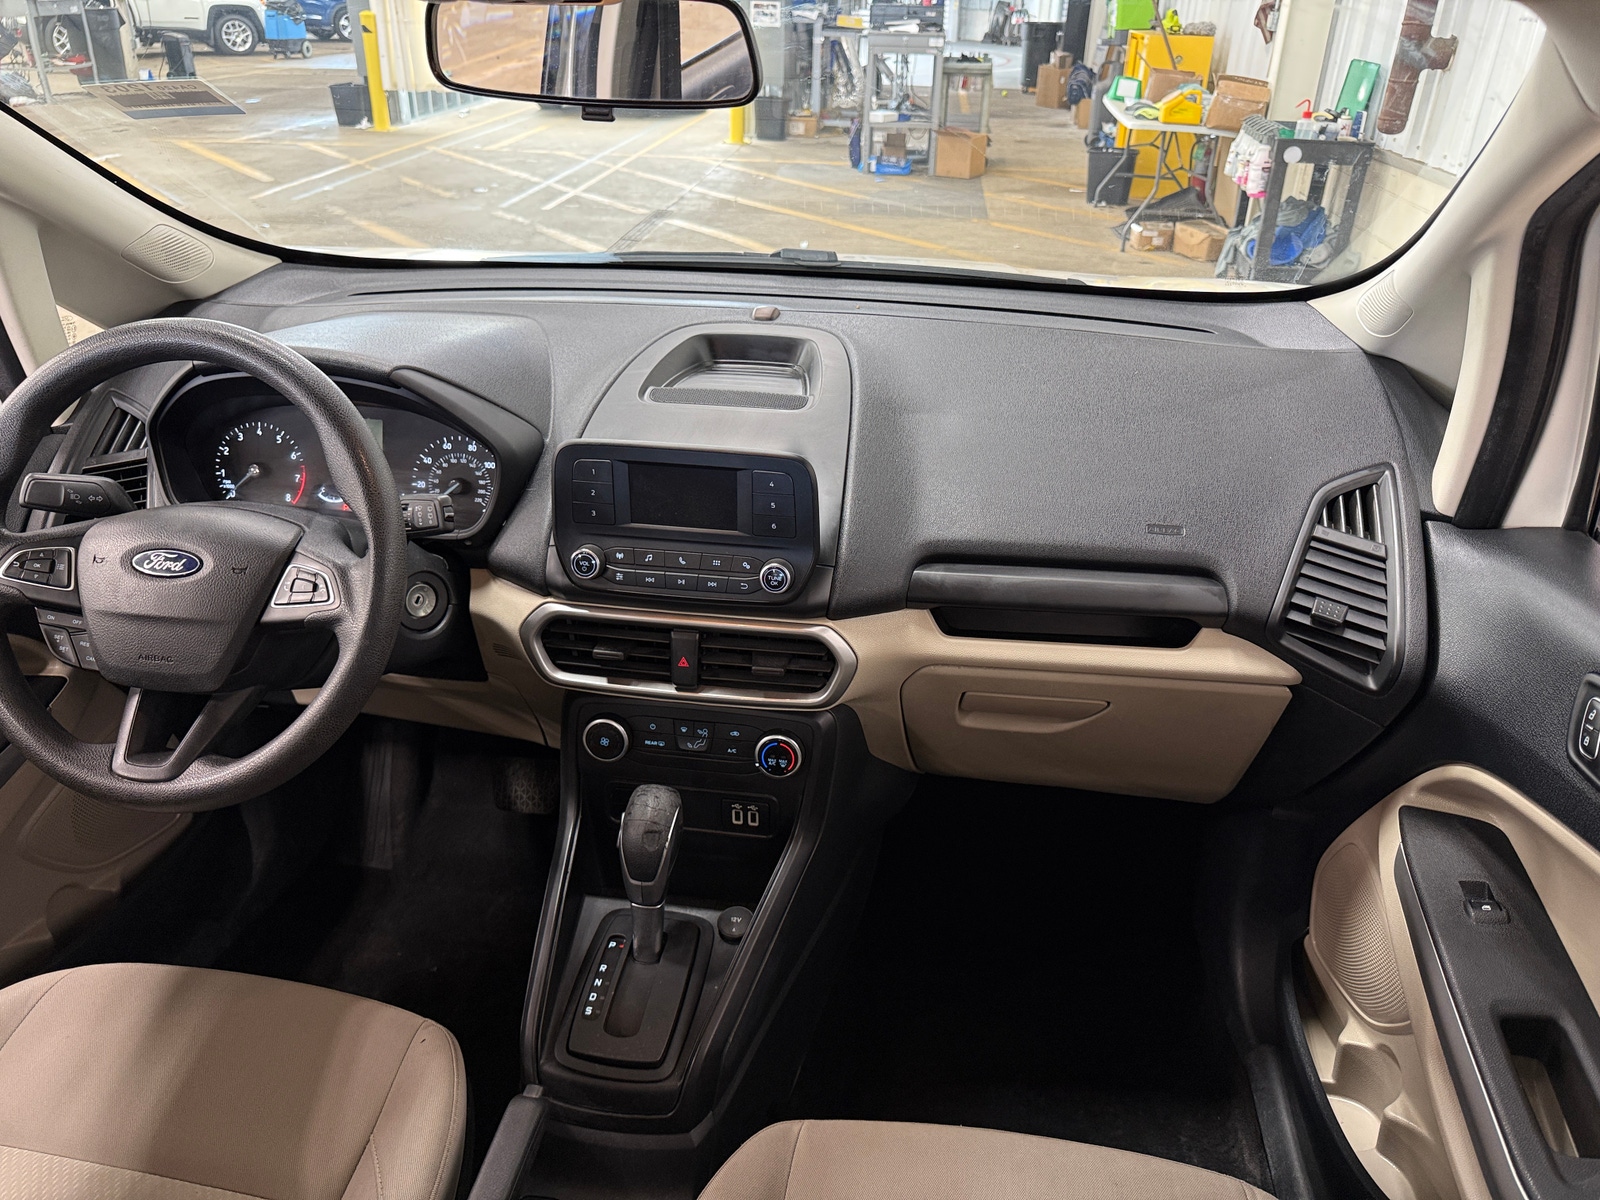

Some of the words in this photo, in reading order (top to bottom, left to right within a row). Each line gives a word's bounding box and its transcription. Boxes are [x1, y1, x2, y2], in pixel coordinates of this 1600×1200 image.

[238, 432, 244, 441] 3
[276, 435, 282, 443] 5
[224, 447, 229, 455] 2
[291, 452, 296, 460] 6
[285, 493, 291, 502] 8
[144, 552, 187, 571] Ford
[599, 964, 607, 972] R
[594, 979, 602, 987] N
[589, 993, 597, 1001] D
[584, 1006, 593, 1015] S
